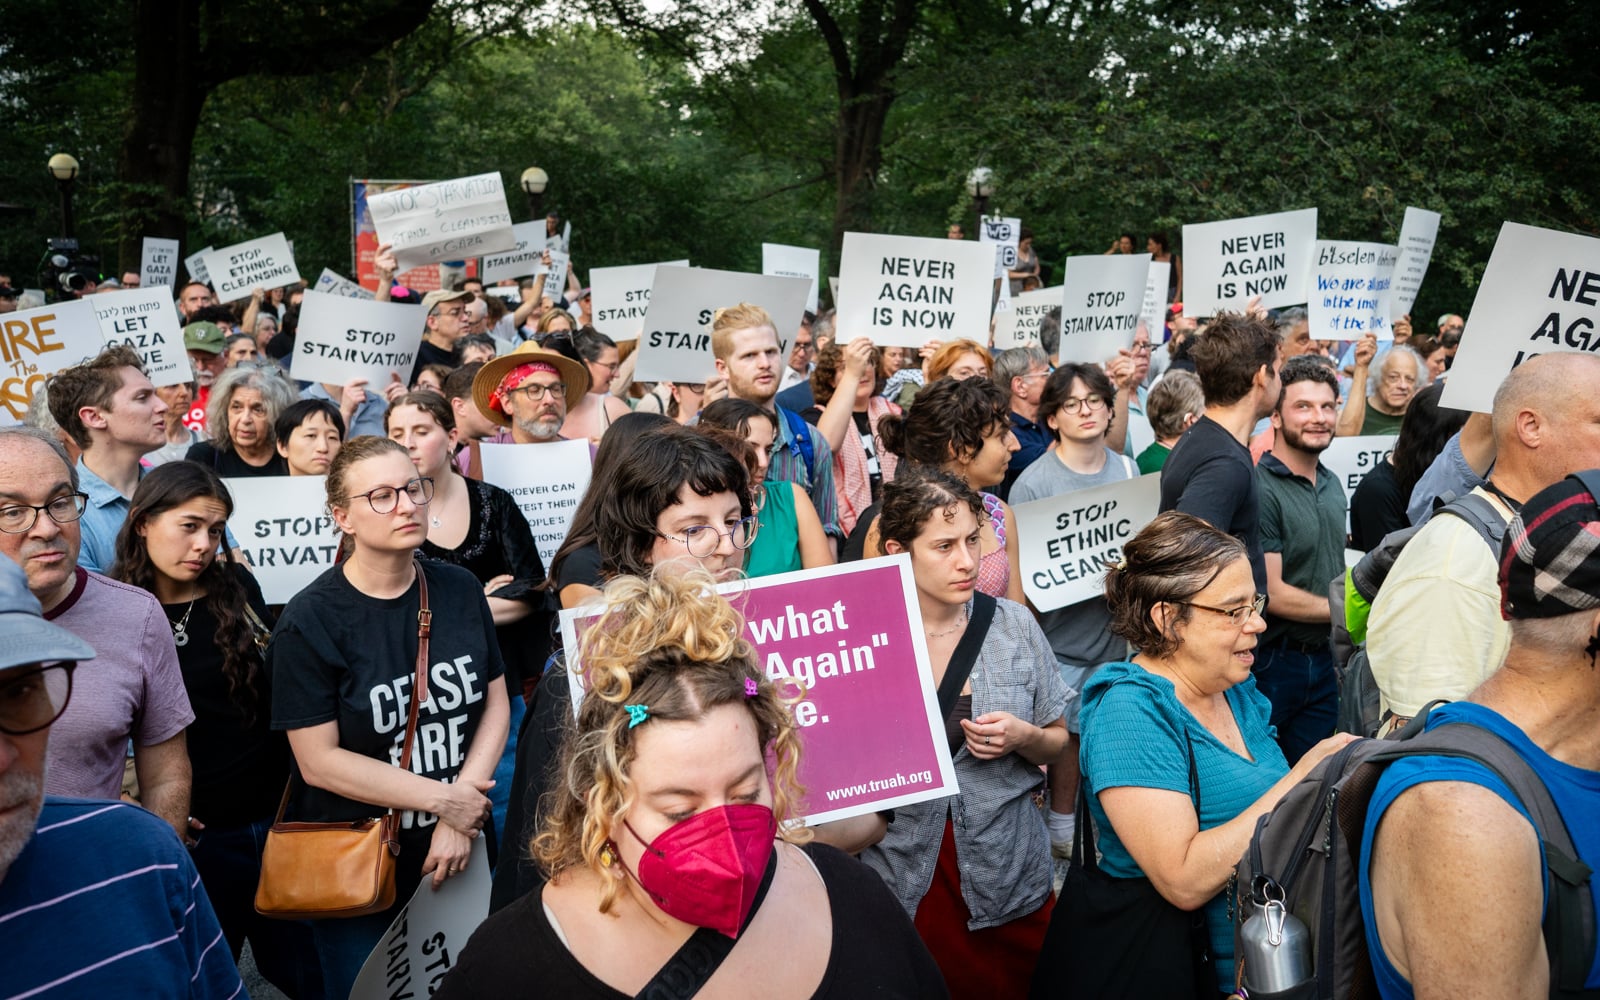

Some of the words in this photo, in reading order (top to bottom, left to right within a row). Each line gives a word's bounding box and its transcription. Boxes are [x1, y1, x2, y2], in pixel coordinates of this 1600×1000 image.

[381, 188, 423, 219] STOP
[443, 236, 483, 253] GAZA
[1221, 231, 1285, 256] NEVER
[152, 254, 168, 263] LET
[229, 248, 261, 265] STOP
[229, 256, 275, 278] ETHNIC
[1221, 252, 1285, 278] AGAIN
[146, 264, 172, 274] GAZA
[221, 264, 292, 293] CLEANSING
[881, 256, 956, 280] NEVER
[150, 275, 169, 285] LIVE
[1217, 282, 1237, 300] IS
[1245, 274, 1288, 297] NOW
[1318, 274, 1339, 292] We
[1341, 278, 1365, 291] are
[878, 282, 954, 304] AGAIN
[1086, 291, 1126, 308] STOP
[598, 306, 649, 321] STARV
[873, 306, 893, 326] IS
[902, 308, 956, 330] NOW
[1343, 316, 1365, 330] the
[113, 315, 148, 334] LET
[345, 328, 396, 346] STOP
[1013, 331, 1025, 340] IS
[302, 341, 414, 366] STARVATION
[9, 359, 38, 376] The
[551, 482, 576, 493] CAN
[546, 498, 577, 509] THEIR
[528, 516, 565, 527] OPLE'S
[1055, 499, 1118, 531] STOP
[254, 517, 333, 538] STOP
[1046, 518, 1131, 560] ETHNIC
[1032, 545, 1124, 590] CLEANS
[747, 599, 849, 646] what
[764, 632, 889, 690] Again"
[825, 769, 933, 801] www.truah.org
